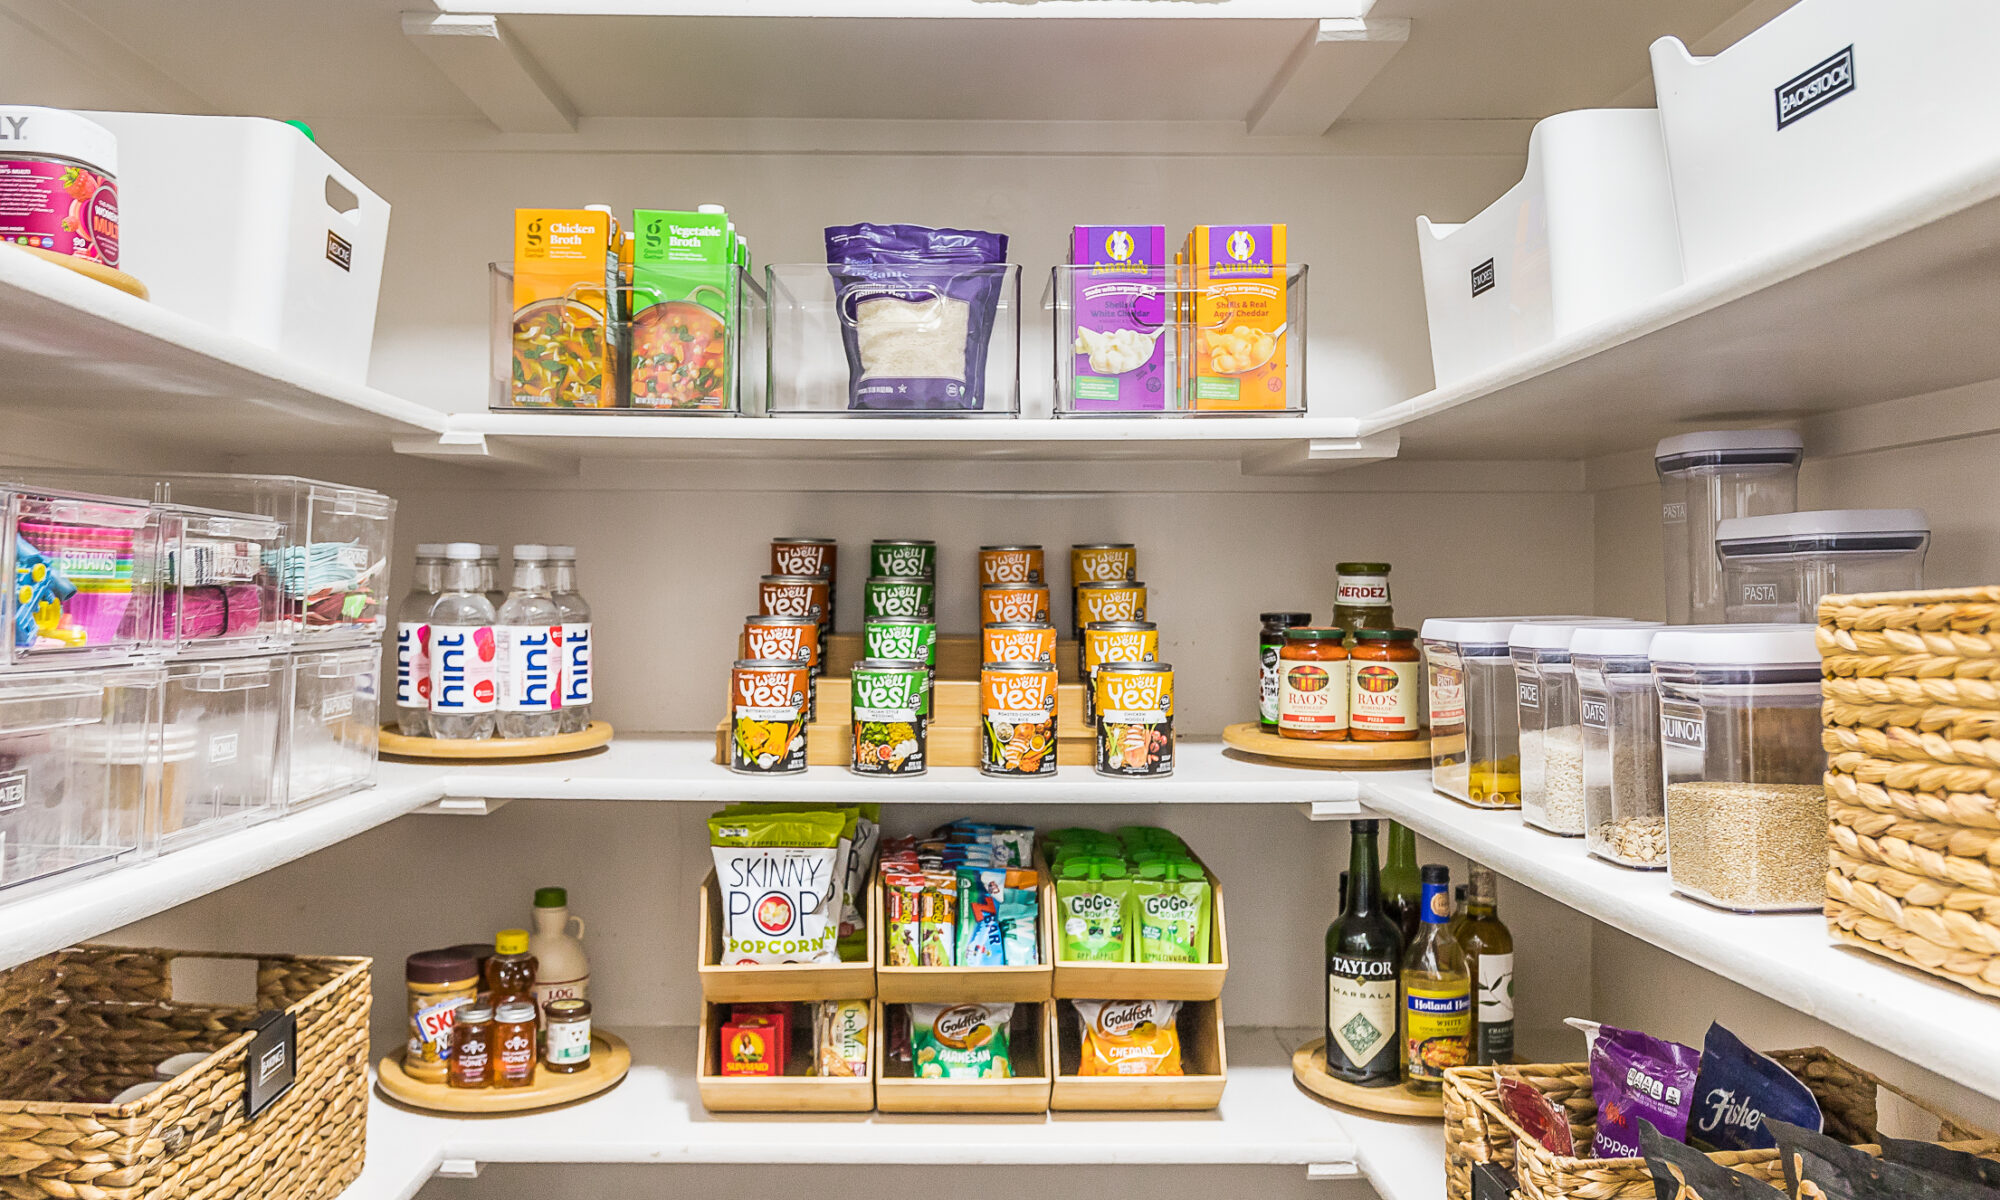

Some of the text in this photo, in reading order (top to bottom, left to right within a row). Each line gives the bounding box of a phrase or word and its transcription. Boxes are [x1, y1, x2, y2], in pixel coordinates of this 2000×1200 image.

[550, 223, 595, 234] Chicken
[669, 225, 721, 238] Vegetable
[550, 235, 582, 245] Broth
[669, 236, 701, 247] Broth
[1092, 259, 1149, 275] Annie's
[1213, 259, 1269, 275] Annie's
[1236, 310, 1269, 318] Cheddar
[1663, 506, 1685, 518] PASTA
[63, 551, 113, 570] STRAWS
[777, 547, 824, 574] Yes!
[879, 548, 925, 576] Yes!
[985, 554, 1030, 582] Yes!
[1083, 552, 1129, 580] Yes!
[764, 587, 813, 616] Yes!
[872, 587, 921, 616] Yes!
[1338, 586, 1386, 598] HERDEZ
[1744, 586, 1775, 600] PASTA
[990, 593, 1038, 622] Yes!
[1088, 592, 1137, 621] Yes!
[749, 628, 802, 660] Yes!
[868, 628, 922, 658] Yes!
[991, 633, 1042, 662] Yes!
[1095, 635, 1146, 664] Yes!
[438, 633, 464, 707] hint
[520, 633, 548, 705] hint
[566, 629, 588, 700] hint
[739, 673, 795, 707] Yes!
[857, 675, 912, 708] Yes!
[992, 676, 1047, 709] Yes!
[1108, 676, 1162, 709] Yes!
[1289, 693, 1328, 705] RAO'S
[1358, 694, 1397, 706] RAO'S
[1520, 685, 1537, 701] RICE
[1583, 703, 1605, 722] OATS
[1662, 717, 1702, 742] QUINOA
[730, 852, 823, 887] SKINNY
[730, 890, 820, 936] POP
[1071, 894, 1112, 914] GoGo
[1147, 895, 1188, 915] GoGo
[729, 937, 824, 954] POPCORN
[1332, 957, 1393, 976] TAYLOR
[548, 988, 573, 999] LOG
[1333, 987, 1391, 999] MARSALA
[1414, 998, 1453, 1011] Holland
[941, 1014, 987, 1034] Goldfish
[1104, 1005, 1153, 1028] Goldfish
[502, 1054, 530, 1063] HONEY
[938, 1049, 991, 1063] PARMESAN
[1109, 1046, 1155, 1058] CHEDDAR
[459, 1058, 488, 1067] HONEY
[1699, 1089, 1766, 1131] Fisher
[1596, 1131, 1639, 1158] opped
